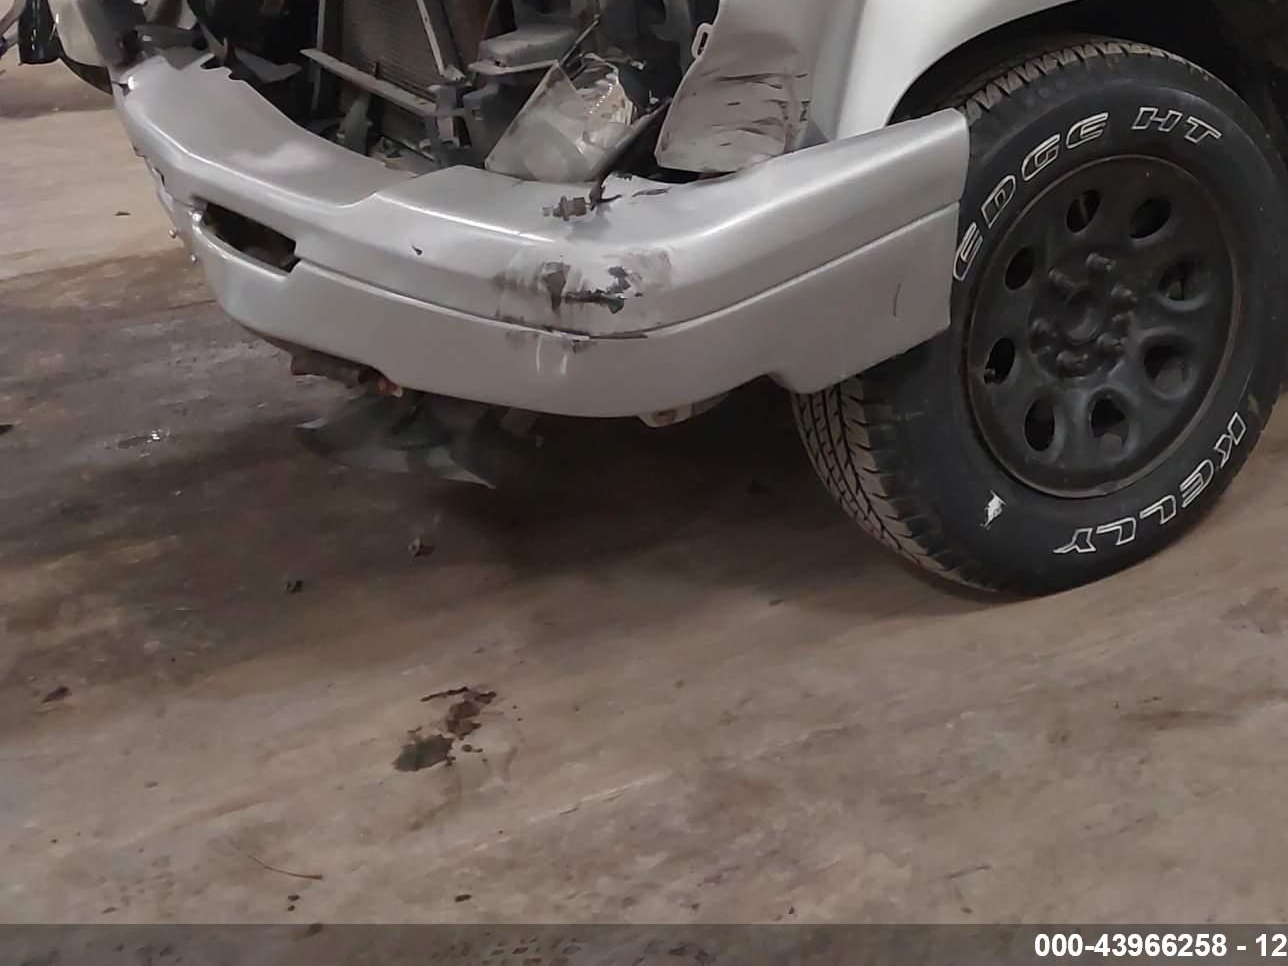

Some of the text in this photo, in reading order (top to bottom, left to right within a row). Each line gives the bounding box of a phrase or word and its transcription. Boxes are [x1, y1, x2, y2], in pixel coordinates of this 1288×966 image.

[953, 106, 1222, 282] EDGE HT
[1053, 411, 1247, 554] KELLY
